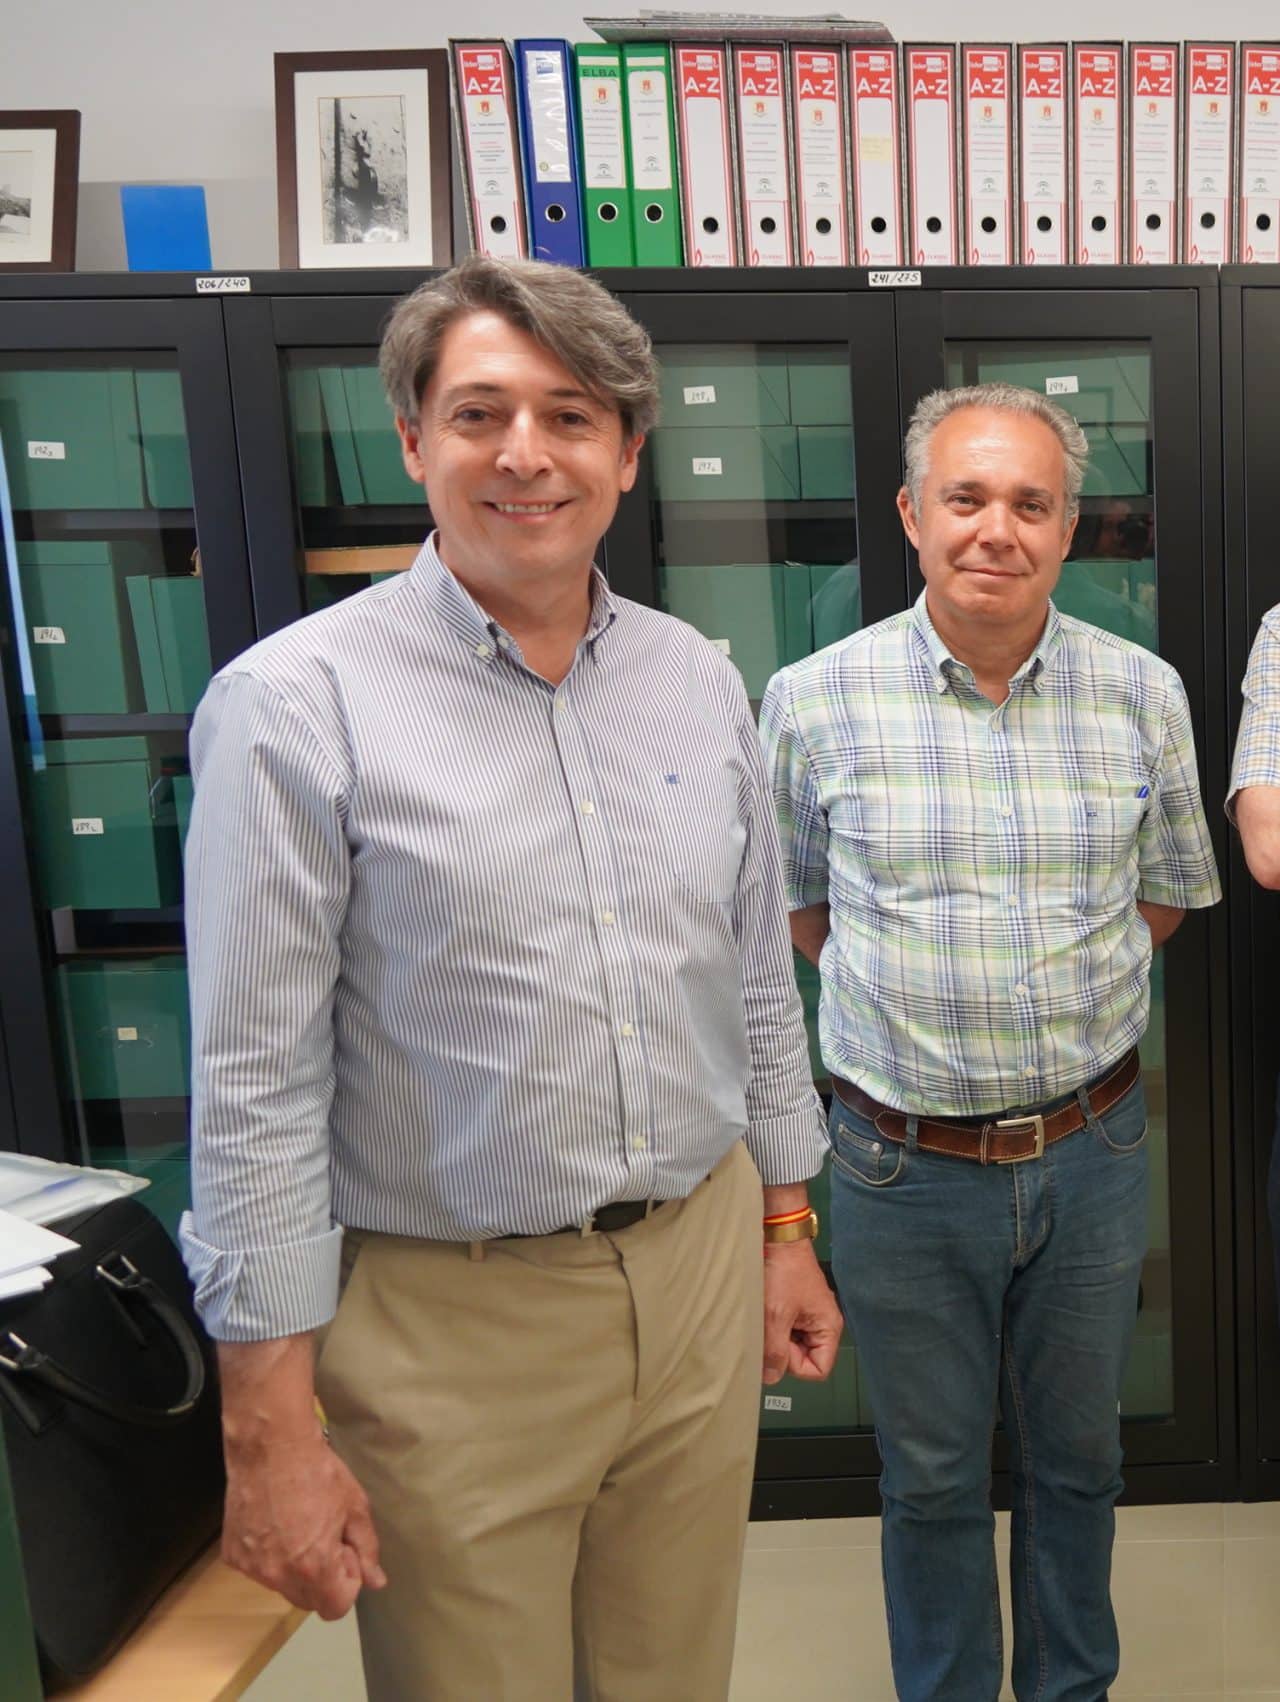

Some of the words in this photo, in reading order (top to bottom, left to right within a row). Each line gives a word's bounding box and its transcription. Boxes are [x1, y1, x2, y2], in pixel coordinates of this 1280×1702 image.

[582, 67, 617, 78] ELBA
[466, 77, 504, 94] A-Z
[684, 77, 721, 94] A-Z
[742, 77, 779, 95] A-Z
[800, 77, 836, 97] A-Z
[857, 77, 893, 95] A-Z
[913, 77, 949, 96] A-Z
[970, 77, 1005, 96] A-Z
[1026, 77, 1061, 95] A-Z
[1081, 77, 1117, 95] A-Z
[1137, 76, 1172, 94] A-Z
[1192, 76, 1227, 94] A-Z
[197, 278, 247, 289] 206/240
[870, 271, 919, 284] 241/275
